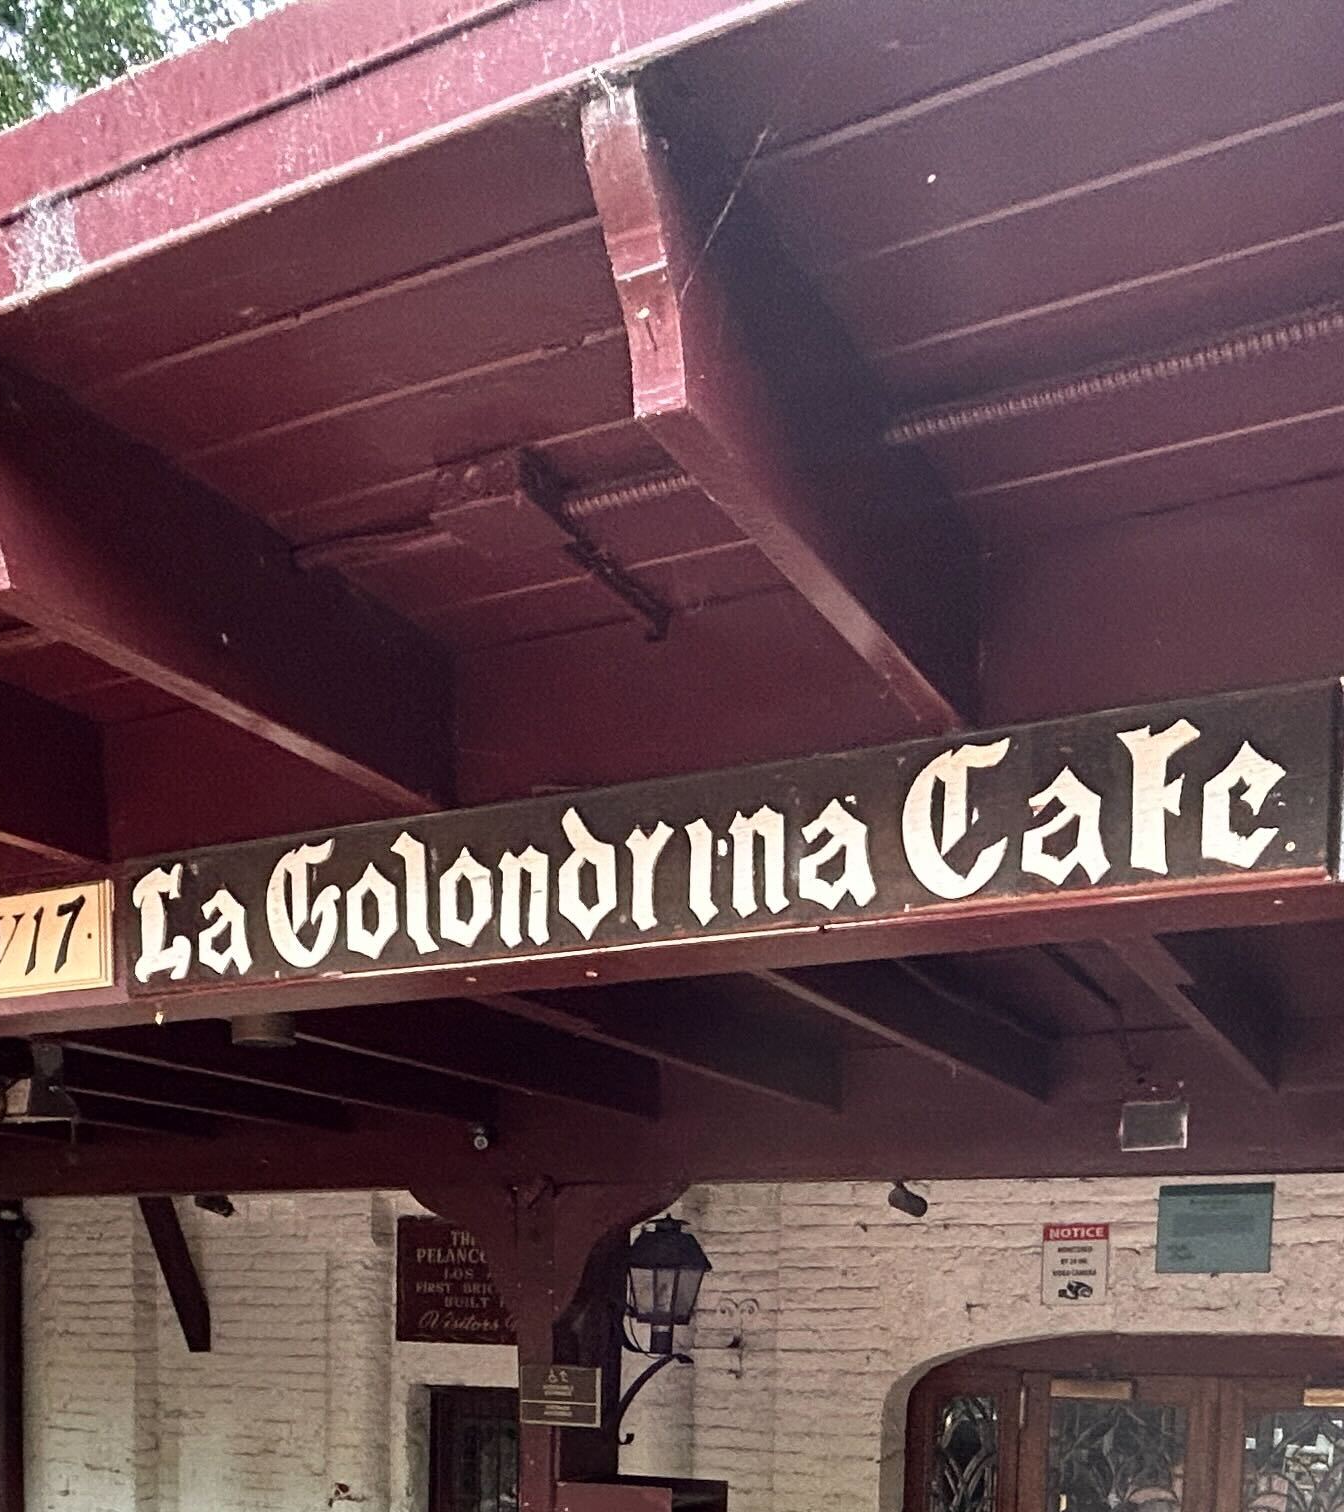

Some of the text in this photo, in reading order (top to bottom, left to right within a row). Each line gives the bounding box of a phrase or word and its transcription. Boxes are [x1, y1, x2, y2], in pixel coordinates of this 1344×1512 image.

[132, 717, 1288, 984] La Golondrina Cafe
[1049, 1226, 1105, 1240] NOTICE
[415, 1280, 495, 1295] FIRST BRIC
[417, 1309, 500, 1331] Visitors
